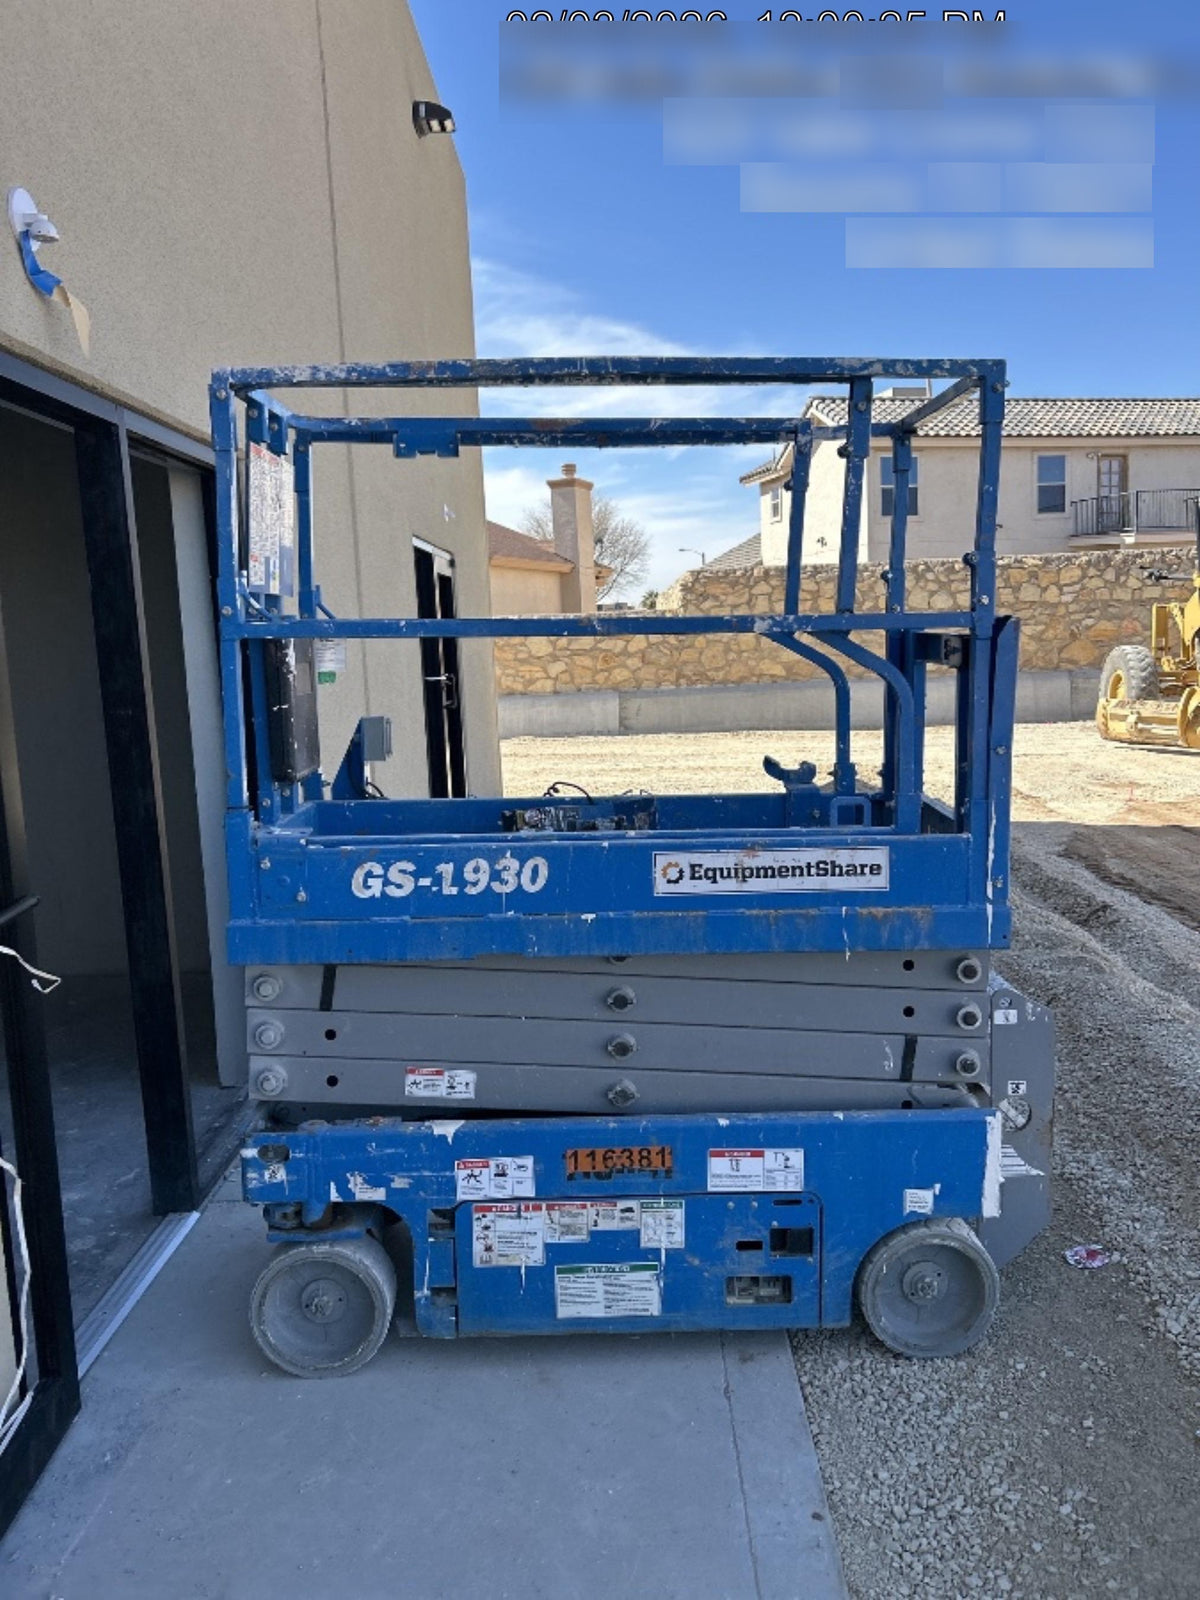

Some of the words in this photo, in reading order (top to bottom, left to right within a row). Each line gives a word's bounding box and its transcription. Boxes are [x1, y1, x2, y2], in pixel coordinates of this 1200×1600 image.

[351, 856, 549, 898] GS-1930
[689, 860, 882, 883] EquipmentShare
[568, 1147, 666, 1170] 116381
